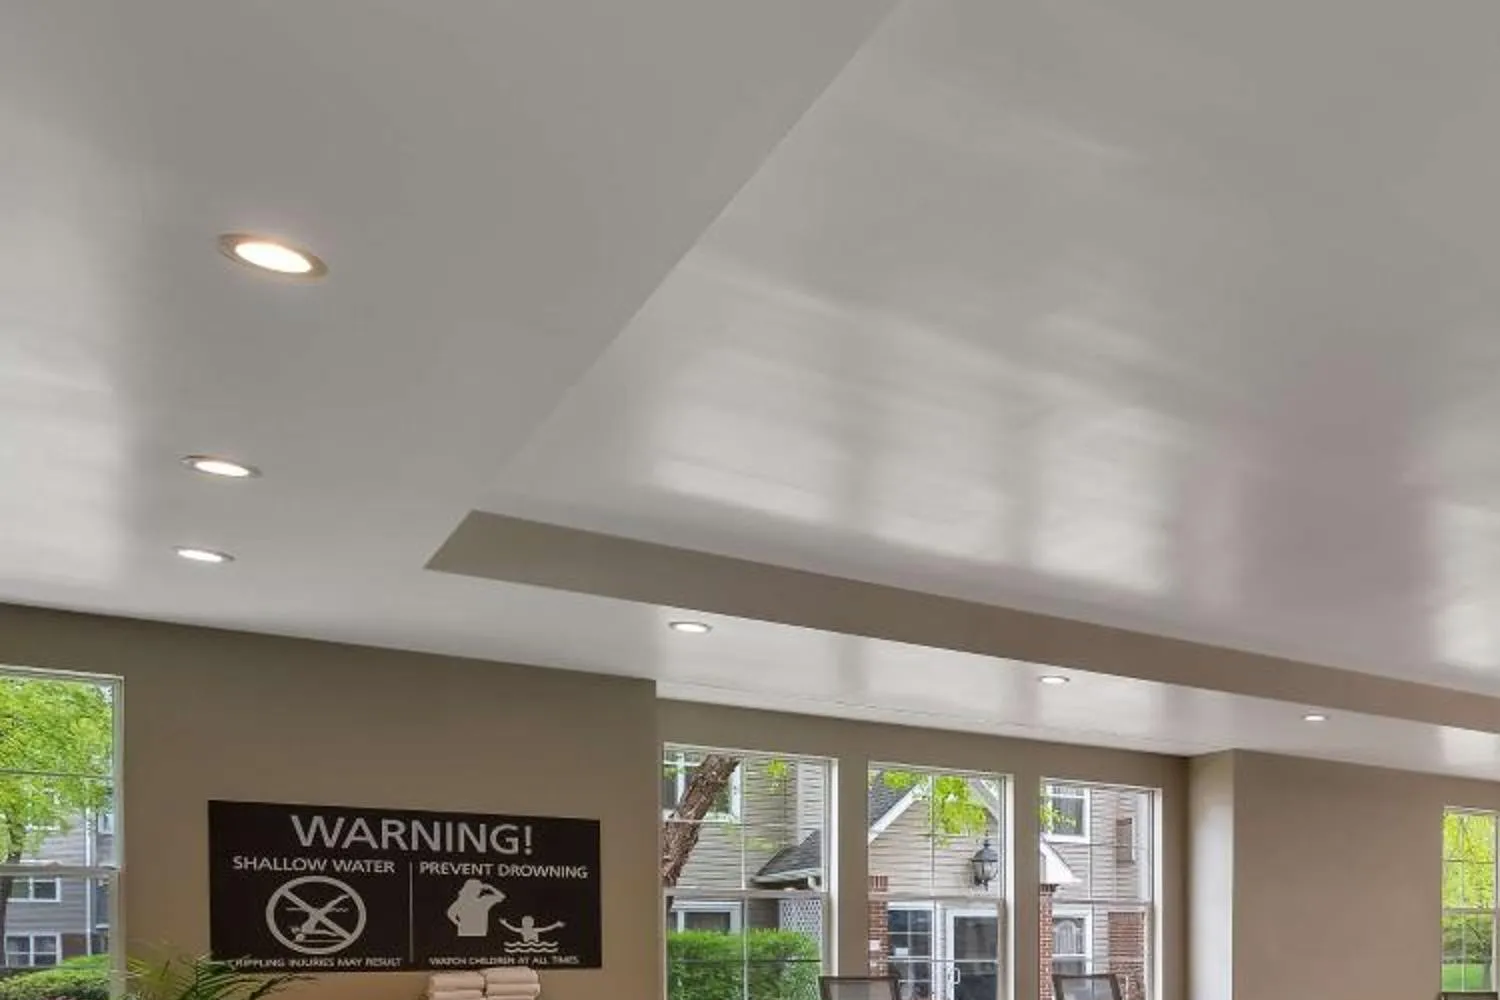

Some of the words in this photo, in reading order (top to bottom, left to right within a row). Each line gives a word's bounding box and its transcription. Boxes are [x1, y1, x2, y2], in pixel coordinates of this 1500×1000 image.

[291, 815, 534, 855] WARNING!
[233, 855, 327, 873] SHALLOW
[331, 859, 396, 874] WATER
[419, 861, 494, 878] PREVENT
[498, 864, 589, 880] DROWNING
[337, 957, 362, 967] MAY
